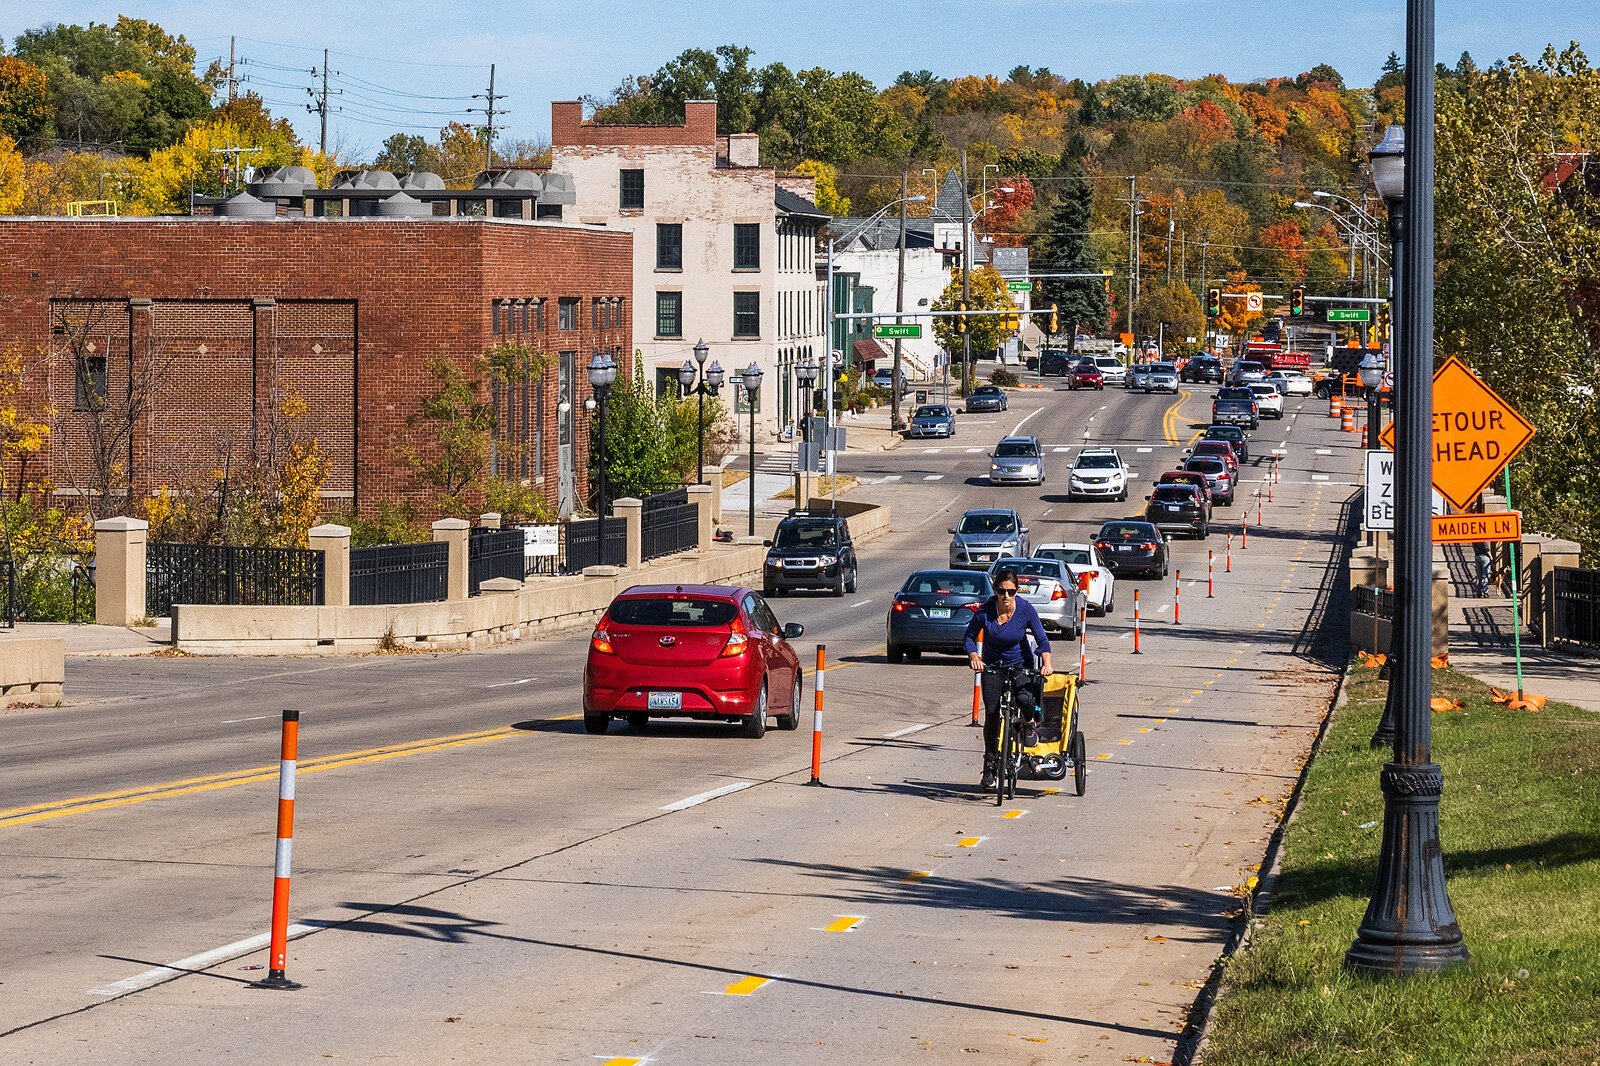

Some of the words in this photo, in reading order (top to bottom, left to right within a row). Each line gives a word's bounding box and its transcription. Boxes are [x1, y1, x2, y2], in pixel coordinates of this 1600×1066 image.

[1340, 311, 1359, 319] Swift
[888, 327, 910, 335] Swift
[1432, 410, 1506, 432] ETOUR
[1432, 440, 1500, 462] HEAD
[1438, 521, 1487, 536] MAIDEN
[1494, 520, 1511, 534] LN
